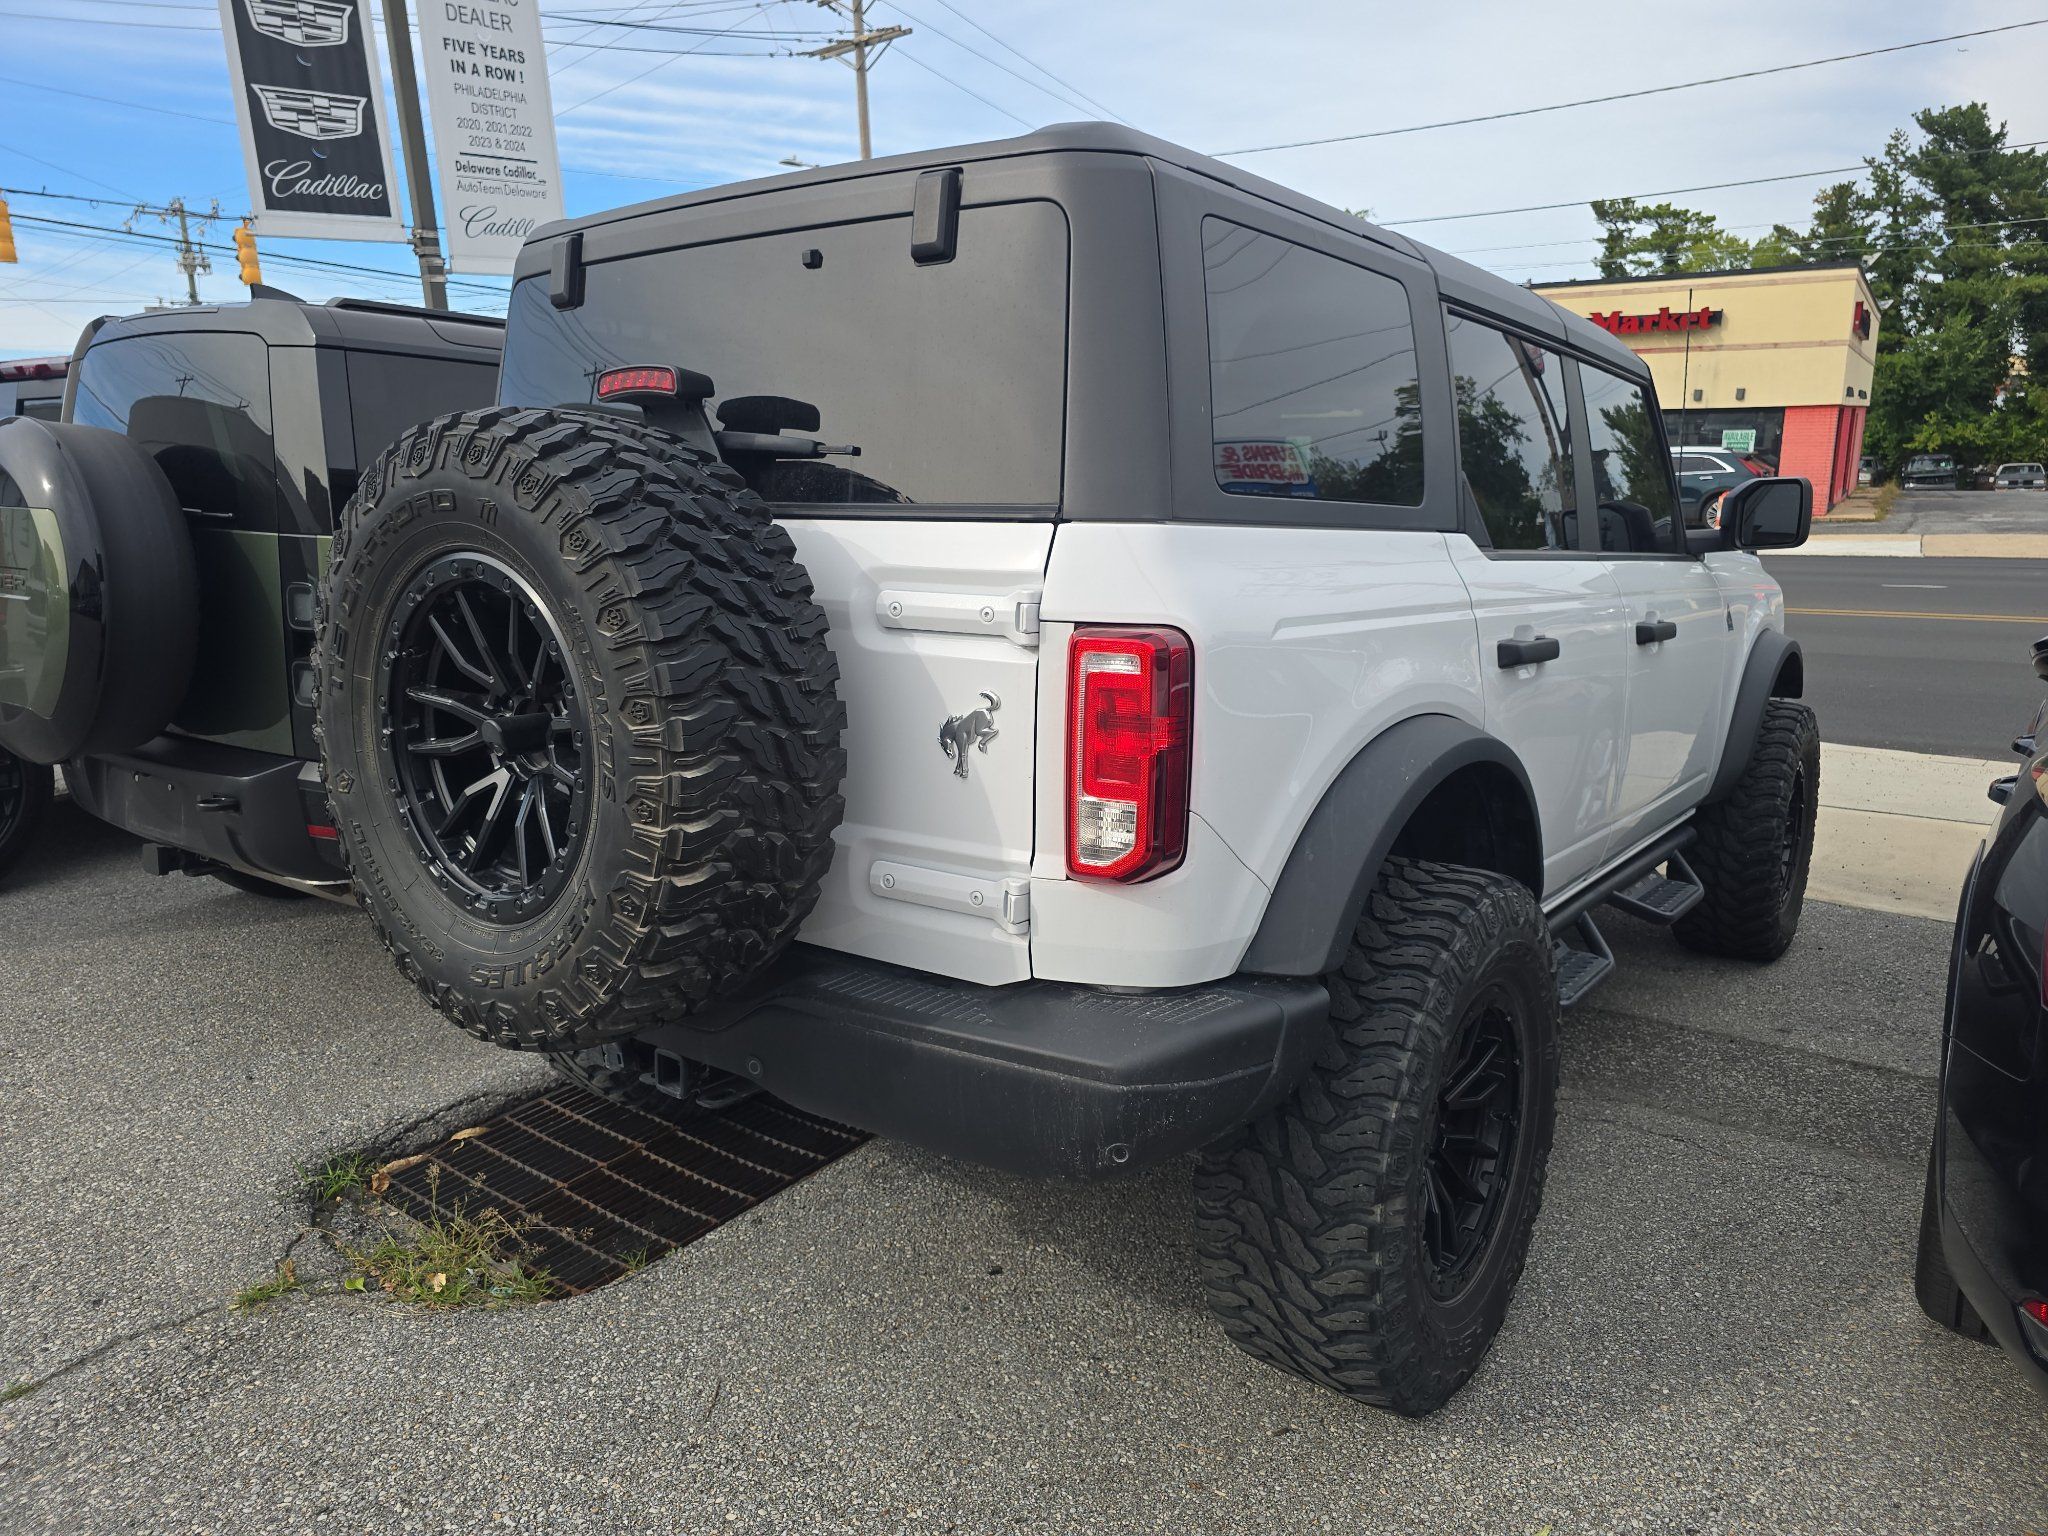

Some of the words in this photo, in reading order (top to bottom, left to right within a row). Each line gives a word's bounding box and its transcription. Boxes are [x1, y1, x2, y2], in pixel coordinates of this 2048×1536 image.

[445, 3, 513, 33] DEALER
[443, 37, 476, 55] FIVE
[479, 43, 526, 64] YEARS
[450, 59, 466, 74] IN
[471, 63, 481, 77] A
[485, 65, 516, 82] ROW
[454, 82, 527, 104] PHILADELPHIA
[471, 102, 518, 119] DISTRICT
[469, 135, 493, 149] 2023
[504, 140, 526, 152] 2024
[263, 159, 383, 201] Cadillac
[455, 160, 501, 176] Delaware
[503, 165, 537, 180] Cadillac
[1589, 306, 1714, 335] Market
